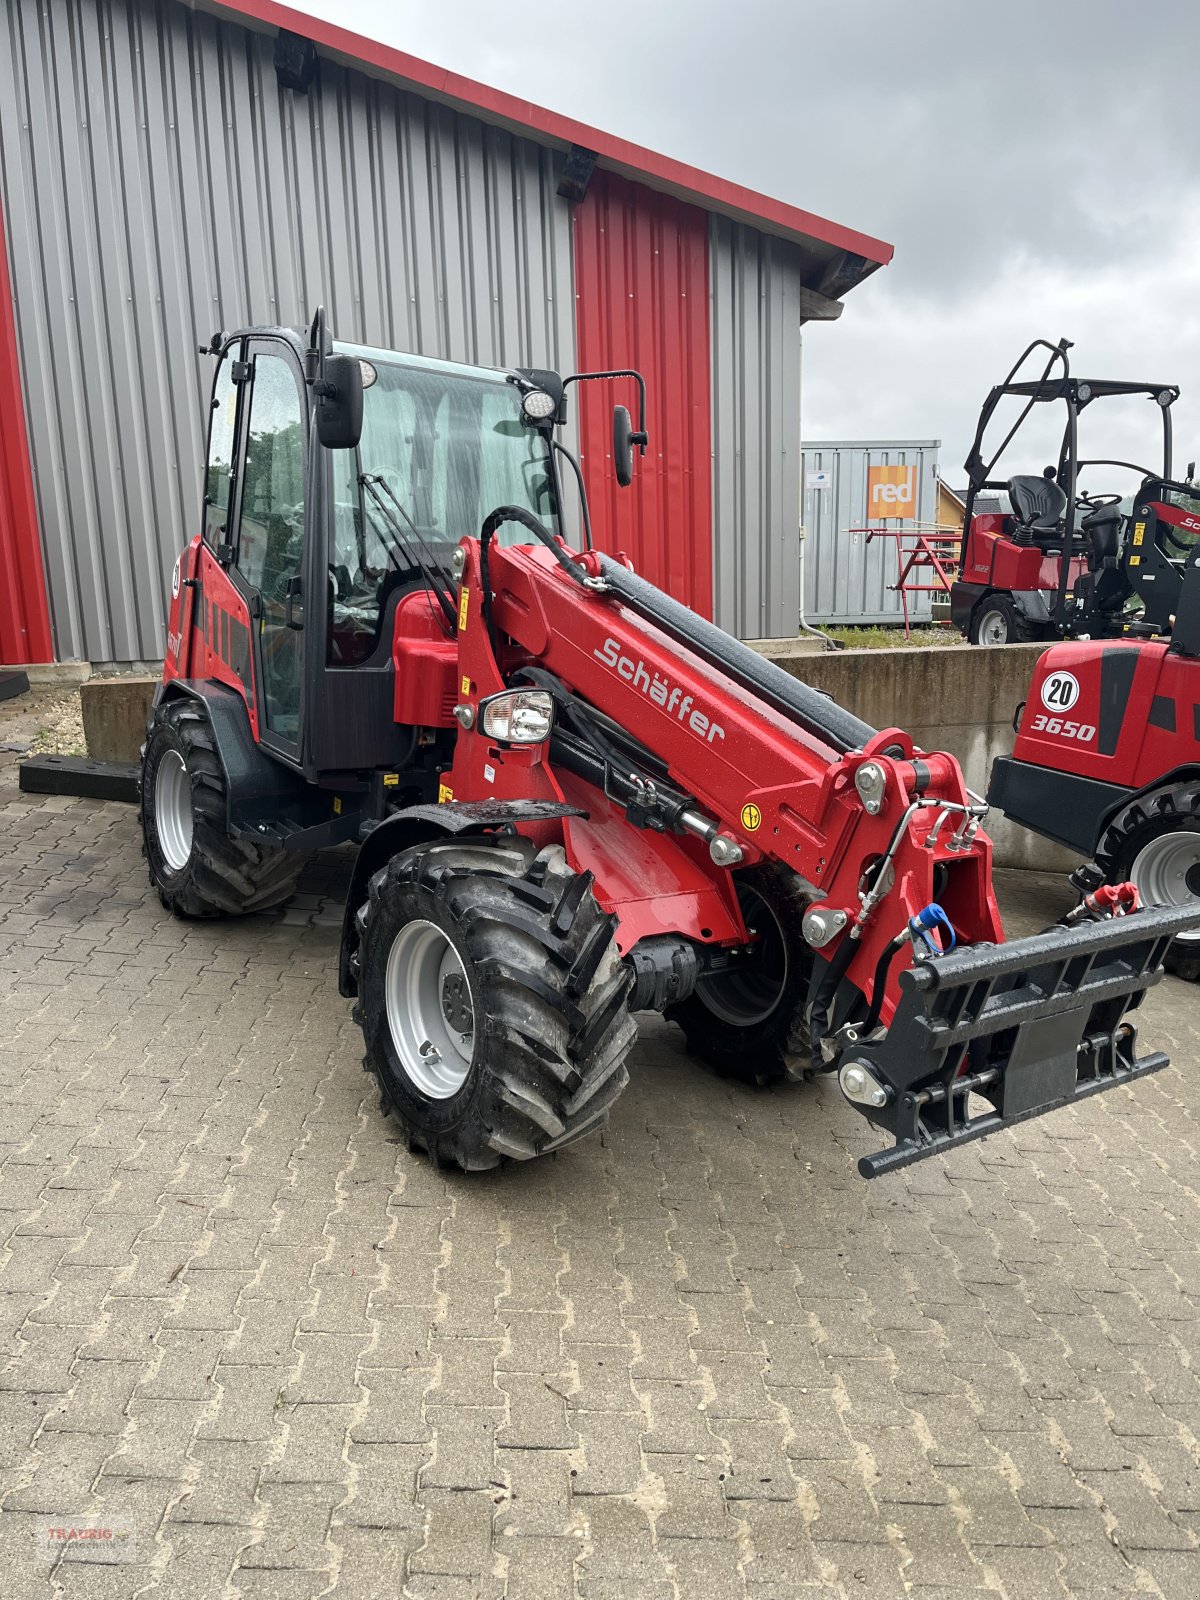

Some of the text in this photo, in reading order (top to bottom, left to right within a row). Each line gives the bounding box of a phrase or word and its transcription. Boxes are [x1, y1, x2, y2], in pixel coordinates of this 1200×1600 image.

[872, 465, 912, 502] red
[593, 638, 725, 743] Schäffer
[1047, 678, 1073, 706] 20
[1030, 714, 1096, 742] 3650
